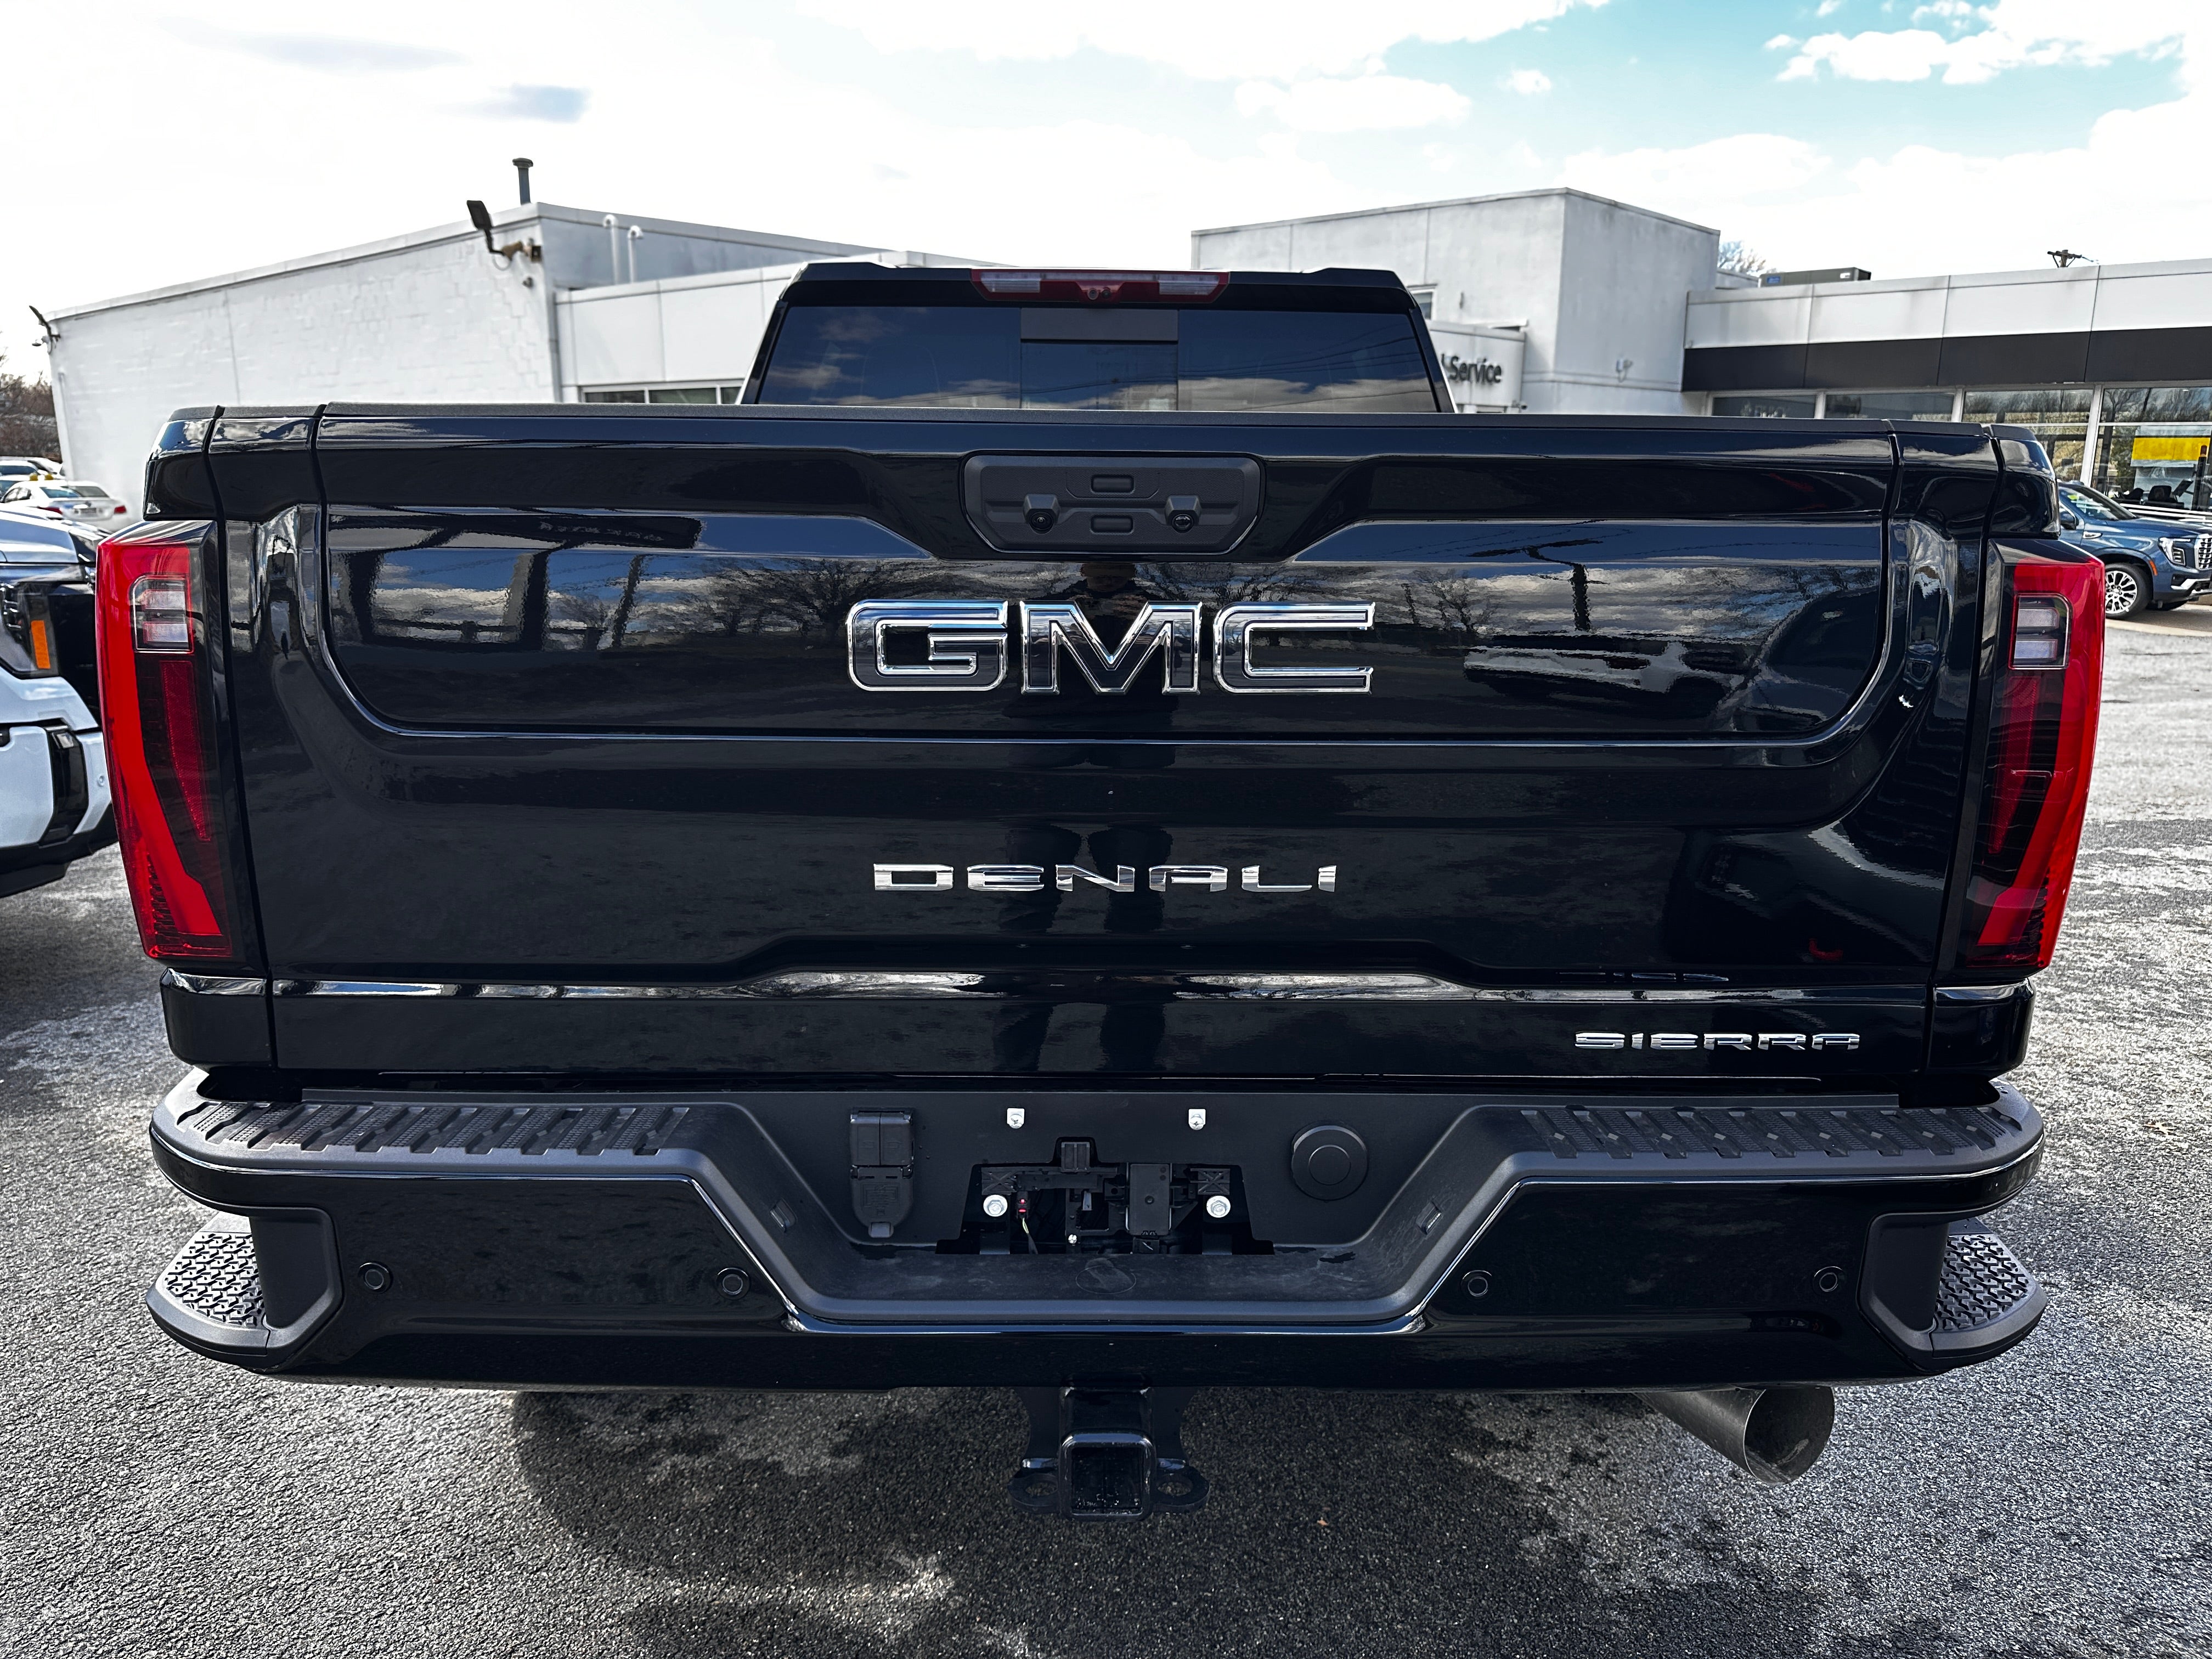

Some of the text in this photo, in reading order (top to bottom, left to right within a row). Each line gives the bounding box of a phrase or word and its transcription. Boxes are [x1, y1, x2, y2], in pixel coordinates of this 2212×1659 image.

[1449, 356, 1502, 383] Service
[846, 599, 1375, 695] GMC
[873, 864, 1336, 892] DENALI
[1575, 1031, 1860, 1050] SIERRA
